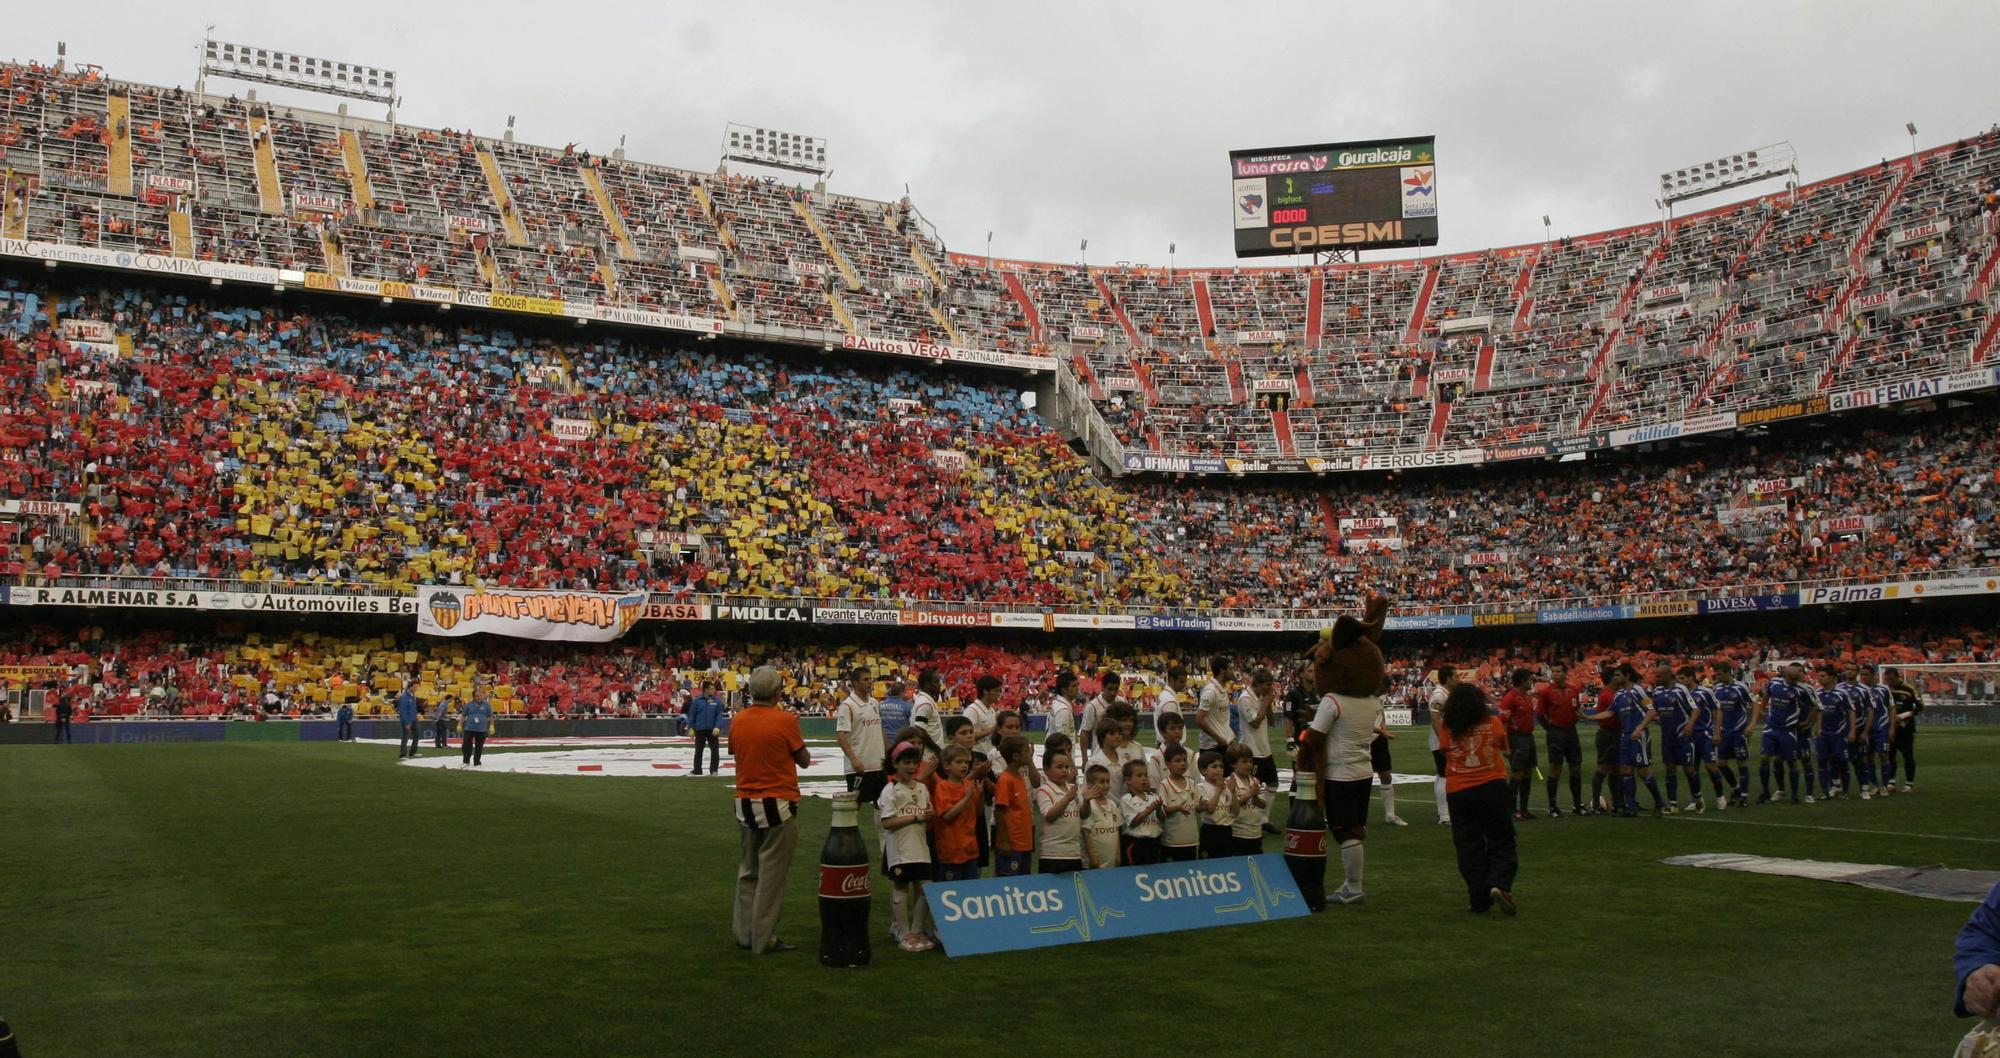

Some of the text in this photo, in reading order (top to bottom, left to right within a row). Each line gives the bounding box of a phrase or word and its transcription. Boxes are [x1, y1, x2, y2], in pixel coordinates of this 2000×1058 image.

[1250, 154, 1291, 163] DISCOTECA
[153, 176, 188, 189] MARCA
[299, 196, 332, 208] MARCA
[1277, 195, 1303, 206] bigfoot
[452, 215, 482, 228] MARCA
[1270, 220, 1402, 248] COESMI
[1904, 225, 1938, 240] MARCA
[0, 240, 108, 264] PAC encimeras
[135, 255, 275, 283] COMPAC encimeras
[1652, 285, 1680, 298] MARCA
[458, 292, 490, 306] VICENTE
[613, 310, 693, 329] MARMOLES POBLA
[1248, 331, 1275, 340] MARCA
[857, 337, 951, 358] Autos VEGA
[1438, 368, 1466, 380] MARCA
[1948, 371, 1979, 382] Aceros
[1258, 380, 1286, 389] MARCA
[1875, 377, 1942, 403] FEMAT
[1948, 379, 1987, 390] Ferrallas
[1739, 403, 1803, 425] autogolden
[557, 423, 590, 435] MARCA
[1628, 415, 1724, 443] chillida Seguridad
[1683, 421, 1735, 433] Permanente
[937, 455, 963, 466] MARCA
[1145, 457, 1189, 471] OFIMAM
[1232, 459, 1269, 471] castellar
[1313, 457, 1351, 470] castellar
[19, 501, 65, 515] MARCA
[1353, 518, 1385, 529] MARCA
[1829, 517, 1865, 530] MARCA
[1471, 553, 1501, 564] MARCA
[38, 590, 199, 606] R. ALMENAR S.A
[1813, 587, 1882, 603] Palma
[261, 594, 379, 612] Automóviles
[1641, 603, 1689, 615] MIRCOMAR
[1708, 597, 1758, 610] DIVESA
[815, 609, 856, 619] Levante
[858, 610, 898, 621] Levante
[918, 612, 976, 625] Disvauto
[1152, 617, 1211, 629] Seul Trading
[1290, 620, 1322, 629] TABERNA
[1135, 869, 1242, 903] Sanitas
[941, 886, 1063, 921] Sanitas
